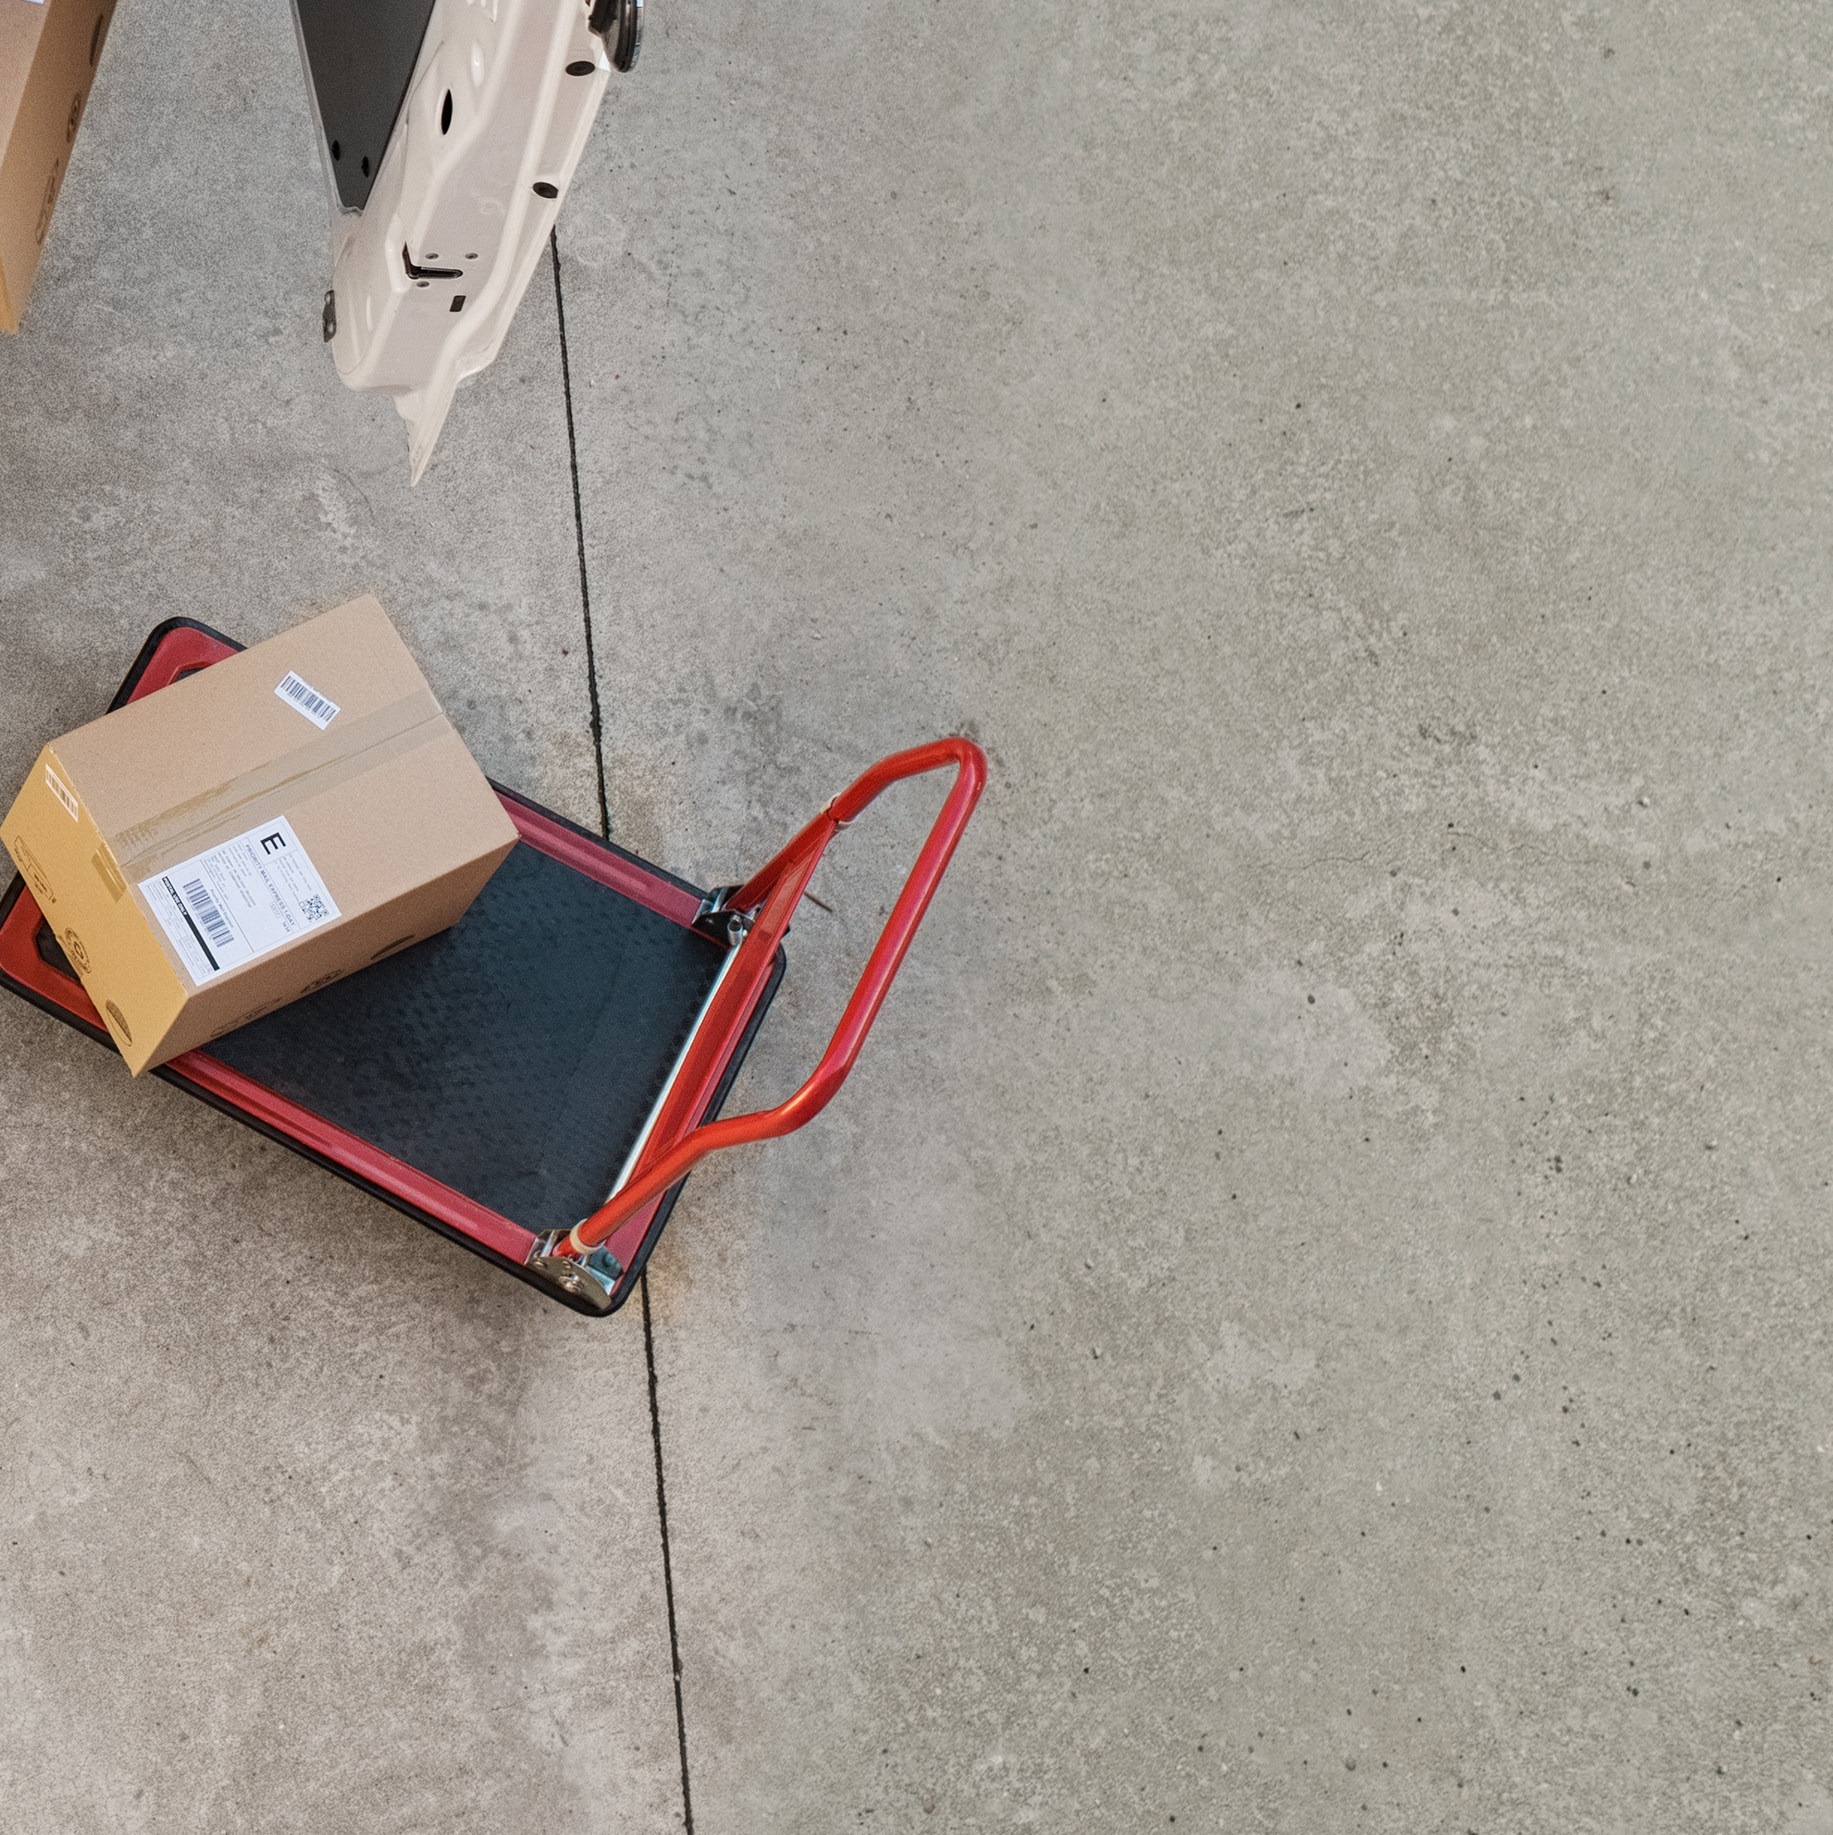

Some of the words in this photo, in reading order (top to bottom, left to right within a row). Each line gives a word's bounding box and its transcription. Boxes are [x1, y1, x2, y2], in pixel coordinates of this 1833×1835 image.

[259, 831, 287, 855] E
[162, 876, 175, 895] POSTAL
[171, 893, 180, 904] USE
[177, 902, 187, 916] ONLY
[243, 843, 263, 870] PRIORITY
[259, 869, 270, 884] MAIL
[267, 883, 286, 910] EXPRESS
[282, 909, 296, 927] 1-DAY
